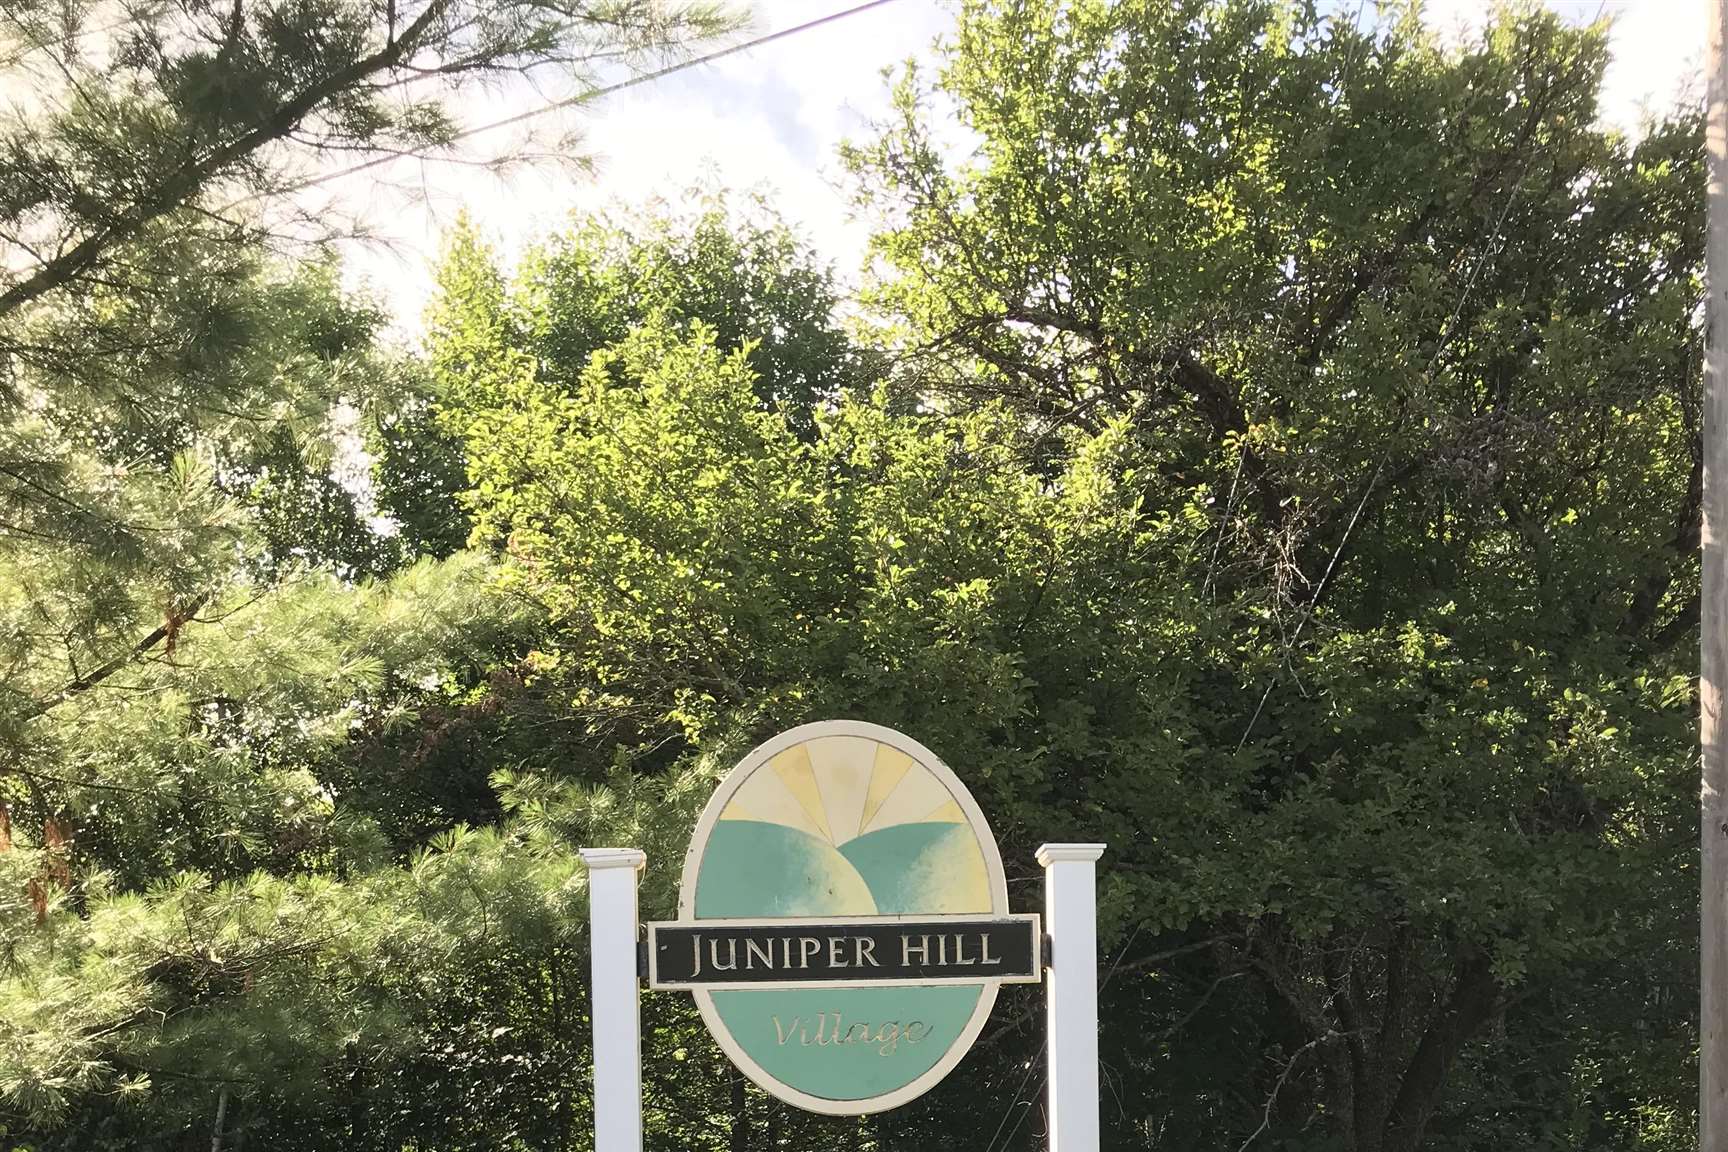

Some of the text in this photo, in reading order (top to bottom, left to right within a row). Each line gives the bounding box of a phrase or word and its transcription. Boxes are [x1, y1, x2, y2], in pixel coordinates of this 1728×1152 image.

[691, 933, 1002, 977] JUNIPER HILL
[771, 1010, 934, 1057] Village
